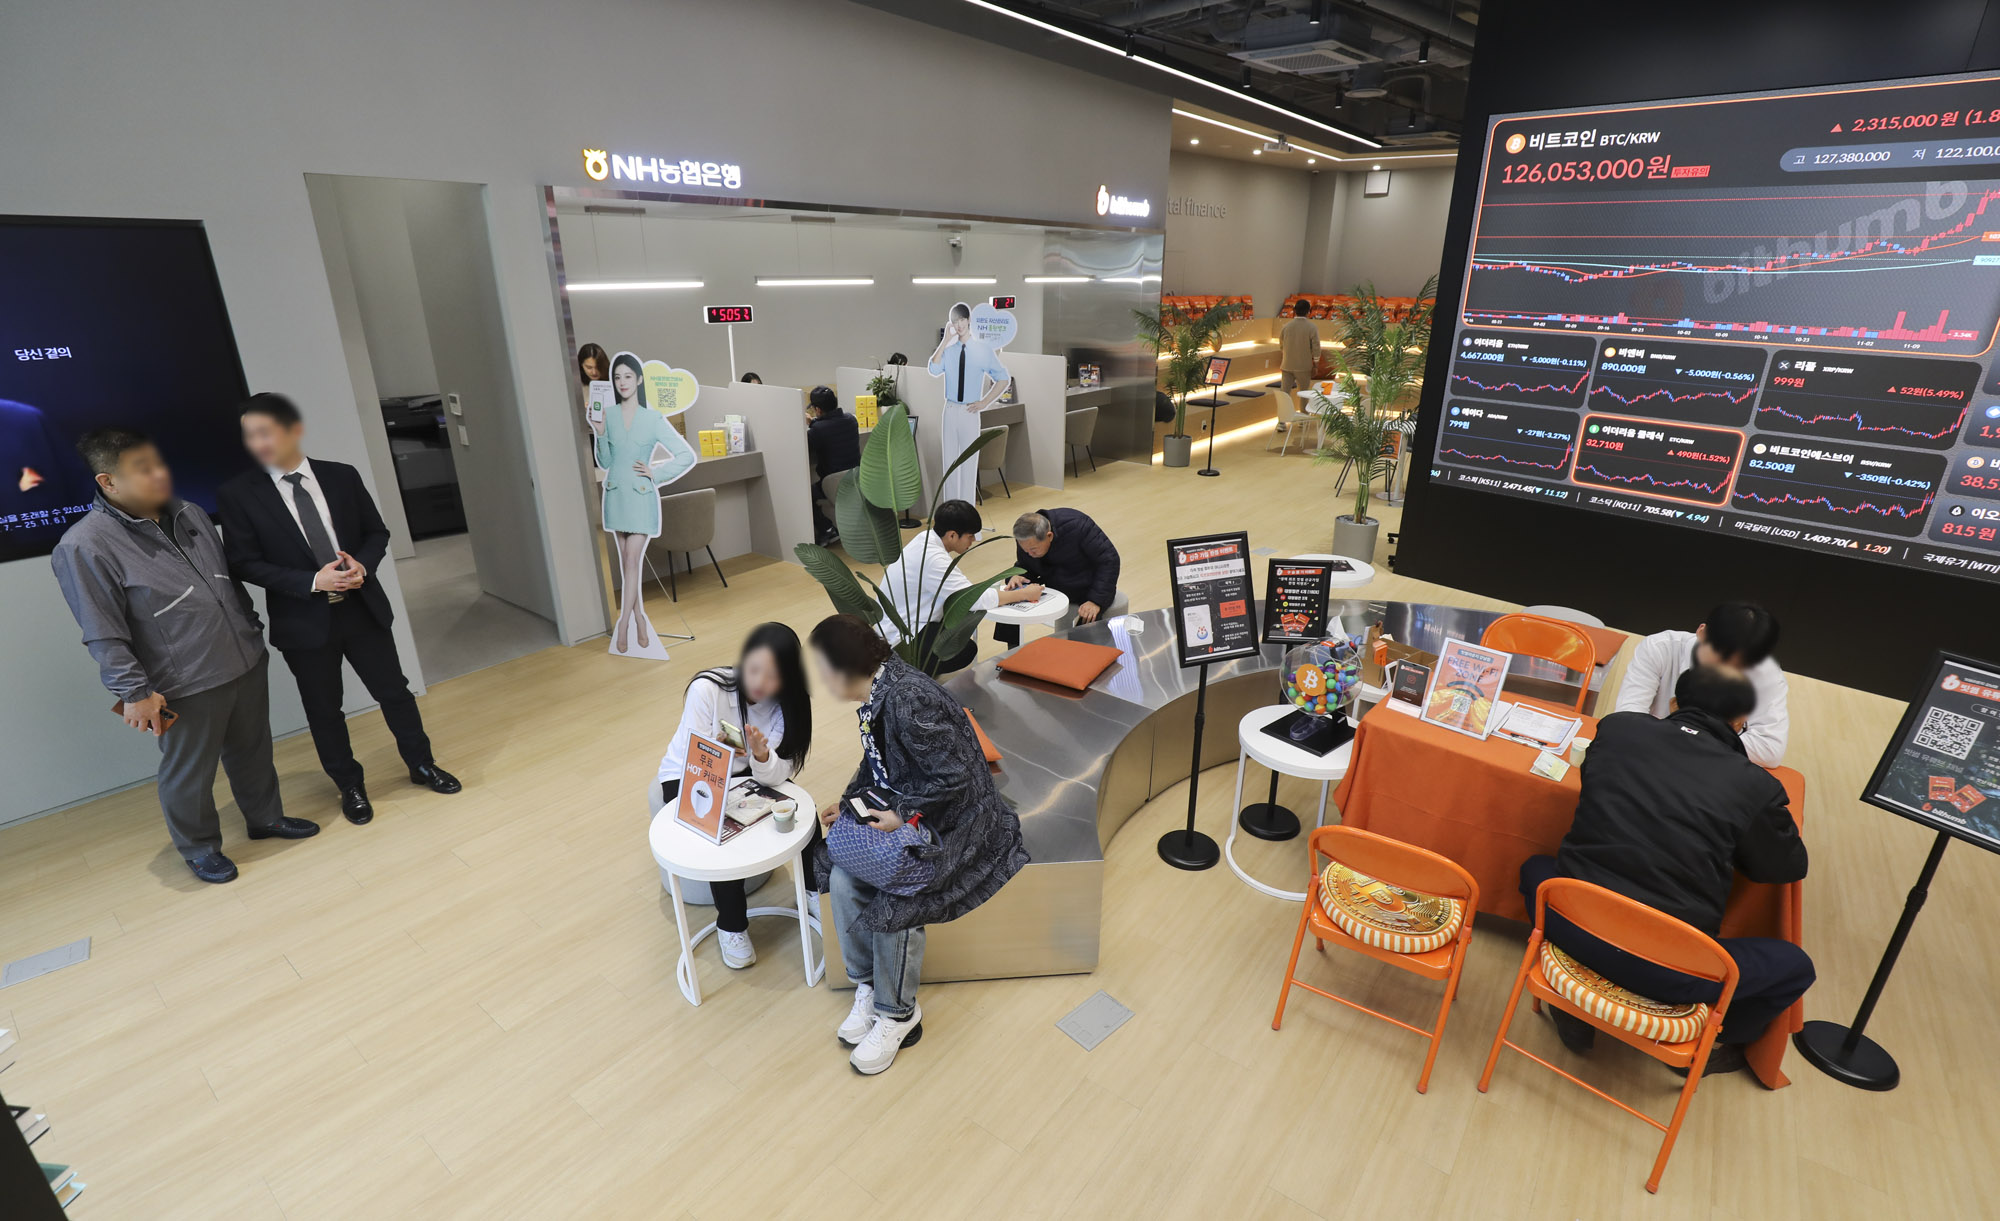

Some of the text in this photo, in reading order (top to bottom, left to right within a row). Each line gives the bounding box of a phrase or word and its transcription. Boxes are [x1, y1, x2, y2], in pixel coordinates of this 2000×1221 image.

[1529, 129, 1660, 150] 비트코인 BTC/KRW
[1794, 155, 1805, 164] 고
[1814, 151, 1890, 164] 127,380,000
[1912, 149, 1925, 160] 저
[1185, 197, 1226, 218] finance
[14, 348, 44, 361] 당신
[1601, 362, 1755, 382] 890,000원 -5,000원(-0.56%)
[1794, 360, 1817, 372] 리플
[1774, 376, 1964, 400] 999원 52원(5.49%)
[1449, 420, 1470, 430] 799원
[1586, 438, 1731, 464] 32,710원 490원(1.52%)
[1749, 459, 1931, 490] 82,500원 -350원(-0.42%)
[51, 508, 61, 516] 수
[1588, 496, 1613, 508] 코스닥
[1612, 499, 1642, 512] [KQ11]
[1686, 513, 1710, 524] 4.94)
[1734, 521, 1770, 535] 미국달러
[1770, 526, 1801, 540] [USD]
[1923, 552, 1969, 569] 국제유가
[1447, 656, 1470, 669] FREE
[1456, 668, 1484, 682] ZONE
[700, 754, 713, 769] 무료
[686, 762, 725, 789] HOT 커피존
[1931, 807, 1967, 825] bithumb
